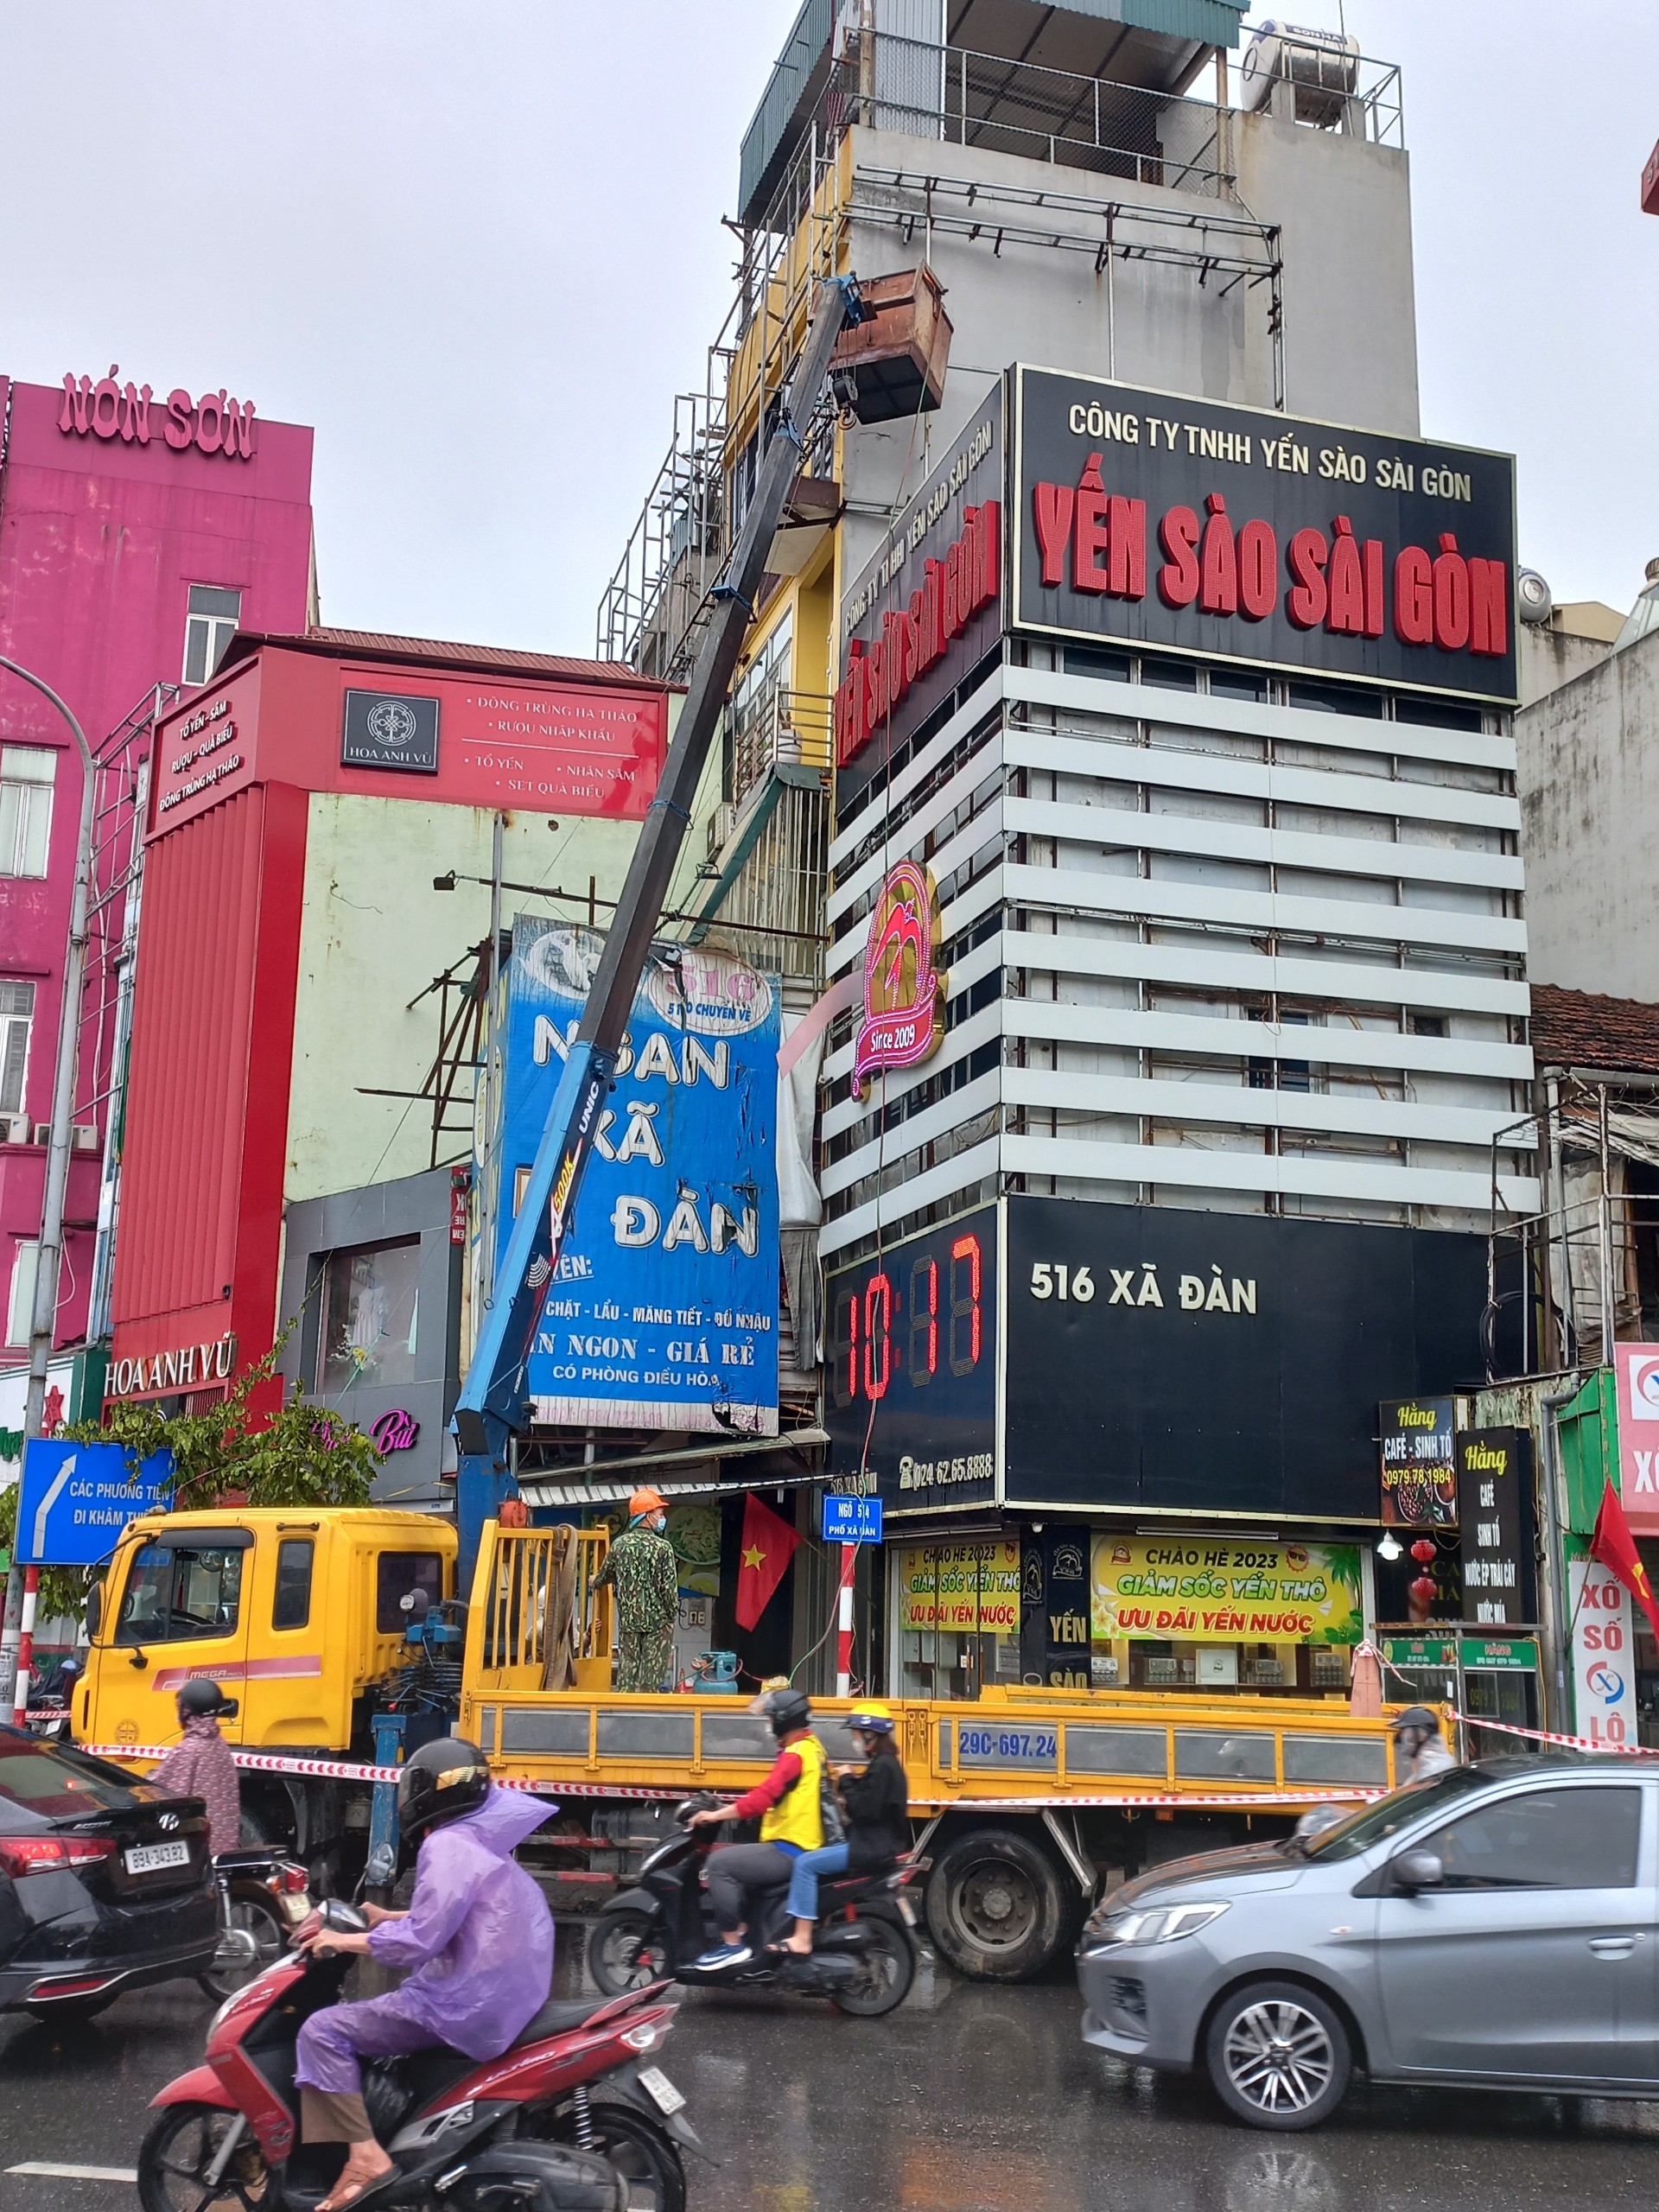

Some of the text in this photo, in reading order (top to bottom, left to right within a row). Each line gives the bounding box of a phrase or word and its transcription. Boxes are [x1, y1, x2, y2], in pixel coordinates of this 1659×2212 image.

[56, 364, 257, 458] NÓN SƠN
[1069, 401, 1471, 502] CÔNG TY TNHH YẾN SÀO SÀI GÒN
[845, 591, 867, 636] CÔNG
[868, 570, 880, 606] TY
[927, 481, 949, 527] SÀO
[1034, 452, 1507, 657] YẾN SÀO SÀI GÒN
[179, 700, 227, 740] TỔ YẾN SÂM
[524, 700, 572, 718] TRÙNG
[576, 708, 595, 721] HẠ
[597, 707, 637, 723] THẢO
[498, 720, 616, 742] RƯỢU NHẬP KHẨU
[172, 721, 233, 772] RƯỢU QUÀ BIẾU
[349, 747, 378, 760] HOA
[381, 749, 410, 763] ANH
[474, 753, 636, 782] TỔ YẾN NHÂN SÂM
[160, 791, 181, 811] ĐÔNG
[182, 778, 206, 798] TRÙNG
[206, 769, 217, 785] HẠ
[508, 779, 605, 798] SET QUÀ BIẾU
[870, 1024, 916, 1052] Since 2009
[578, 1082, 599, 1134] UNIC
[611, 1190, 760, 1256] ĐÀN
[1030, 1262, 1256, 1314] 516 XÃ ĐÀN
[546, 1299, 582, 1321] CHẶT
[594, 1299, 620, 1320] LẨU
[632, 1305, 672, 1325] MĂNG
[677, 1305, 702, 1326] TIẾT
[104, 1331, 233, 1397] HOA ANH VŨ
[568, 1334, 638, 1359] NGON
[666, 1338, 709, 1363] GIÁ
[721, 1336, 754, 1366] RẺ
[553, 1363, 720, 1388] CÓ PHÒNG ĐIỀU HÒA
[1397, 1402, 1437, 1431] Hằng
[1384, 1427, 1452, 1460] CAFÉ SINH TỐ
[1465, 1440, 1508, 1476] Hằng
[1427, 1468, 1451, 1484] 1984
[1633, 1447, 1659, 1493] X
[69, 1478, 94, 1497] CÁC
[97, 1483, 143, 1500] PHƯƠNG
[1480, 1478, 1495, 1507] CAFÉ
[73, 1509, 86, 1524] ĐI
[88, 1507, 123, 1525] KHÂM
[838, 1501, 870, 1519] NGÕ 54
[829, 1523, 846, 1535] PHỐ
[847, 1525, 858, 1535] XÃ
[1478, 1515, 1500, 1548] SINH TỐ
[968, 1545, 995, 1561] 2023
[1146, 1546, 1278, 1569] CHÀO HÈ 2023
[911, 1566, 936, 1593] GIẢM
[941, 1562, 965, 1593] SỐC
[966, 1565, 994, 1593] YẾN
[1117, 1569, 1327, 1602] GIẢM SỐC YẾN THÔ
[1581, 1576, 1620, 1610] XỔ
[910, 1599, 1015, 1626] ƯU ĐÃI YẾN NƯỚC
[1049, 1608, 1086, 1643] YẾN
[1117, 1605, 1315, 1635] ƯU ĐÃI YẾN NƯỚC
[1583, 1618, 1623, 1650] SỐ
[190, 1669, 226, 1680] MEGA
[1050, 1668, 1088, 1688] SÀO
[1590, 1712, 1626, 1742] LÔ
